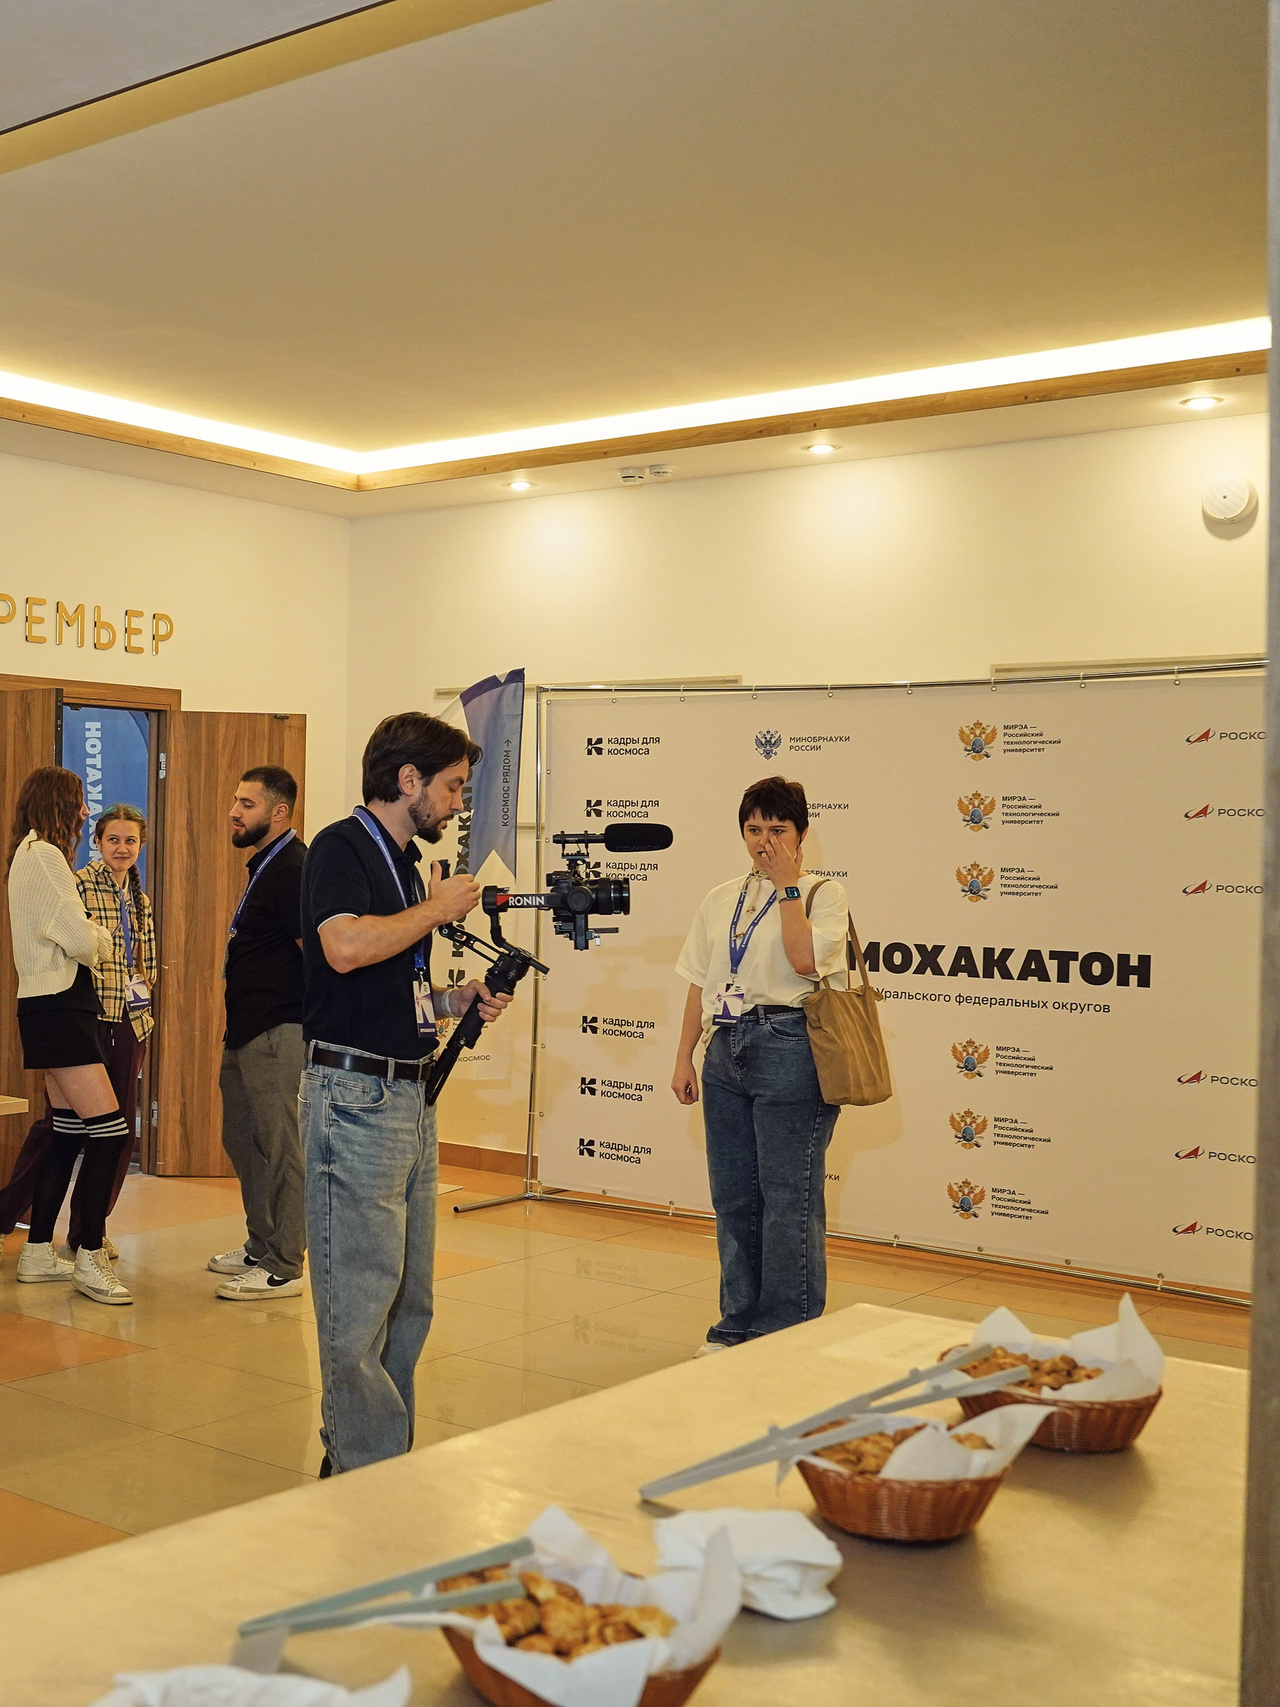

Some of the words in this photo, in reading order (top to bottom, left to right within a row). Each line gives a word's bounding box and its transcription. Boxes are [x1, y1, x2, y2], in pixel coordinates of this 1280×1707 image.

[1003, 731, 1044, 739] Российский
[1219, 731, 1267, 741] РОСКО
[608, 737, 639, 747] кадры
[641, 737, 660, 745] для
[1003, 738, 1062, 747] технологический
[1003, 747, 1046, 755] университет
[504, 750, 513, 783] РЯДОМ
[1002, 795, 1027, 803] МИРЭА
[500, 784, 510, 828] КОСМОС
[607, 800, 638, 809] кадры
[640, 800, 659, 808] для
[1001, 803, 1043, 811] Российский
[607, 810, 648, 818] космоса
[1001, 810, 1061, 818] технологический
[1217, 808, 1265, 818] РОСКО
[1001, 818, 1044, 826] университет
[606, 862, 637, 872] кадры
[639, 863, 658, 871] для
[1000, 883, 1059, 891] технологический
[1215, 884, 1264, 895] РОСКО
[999, 890, 1043, 898] университет
[508, 896, 545, 907] RONIN
[848, 941, 1152, 988] МОХАКАТОН
[876, 988, 951, 1003] Уральского
[955, 993, 1048, 1009] федеральных
[1052, 1001, 1110, 1014] округов
[603, 1017, 634, 1028] кадры
[636, 1021, 655, 1029] для
[602, 1028, 644, 1039] космоса
[996, 1045, 1021, 1054] МИРЭА
[458, 1055, 491, 1063] КОСМОС
[995, 1053, 1037, 1062] Российский
[995, 1060, 1054, 1071] технологический
[995, 1068, 1038, 1078] университет
[601, 1079, 633, 1090] кадры
[634, 1083, 653, 1092] для
[1210, 1075, 1259, 1088] РОСКО
[601, 1090, 642, 1102] космоса
[994, 1116, 1019, 1126] МИРЭА
[993, 1124, 1035, 1134] Российский
[993, 1131, 1052, 1143] технологический
[599, 1141, 631, 1152] кадры
[632, 1146, 651, 1155] для
[993, 1139, 1036, 1150] университет
[599, 1152, 641, 1164] космоса
[1208, 1151, 1257, 1164] РОСКО
[991, 1187, 1016, 1197] МИРЭА
[991, 1194, 1032, 1206] Российский
[990, 1202, 1049, 1216] технологический
[990, 1209, 1033, 1222] университет
[1205, 1226, 1254, 1241] РОСКО
